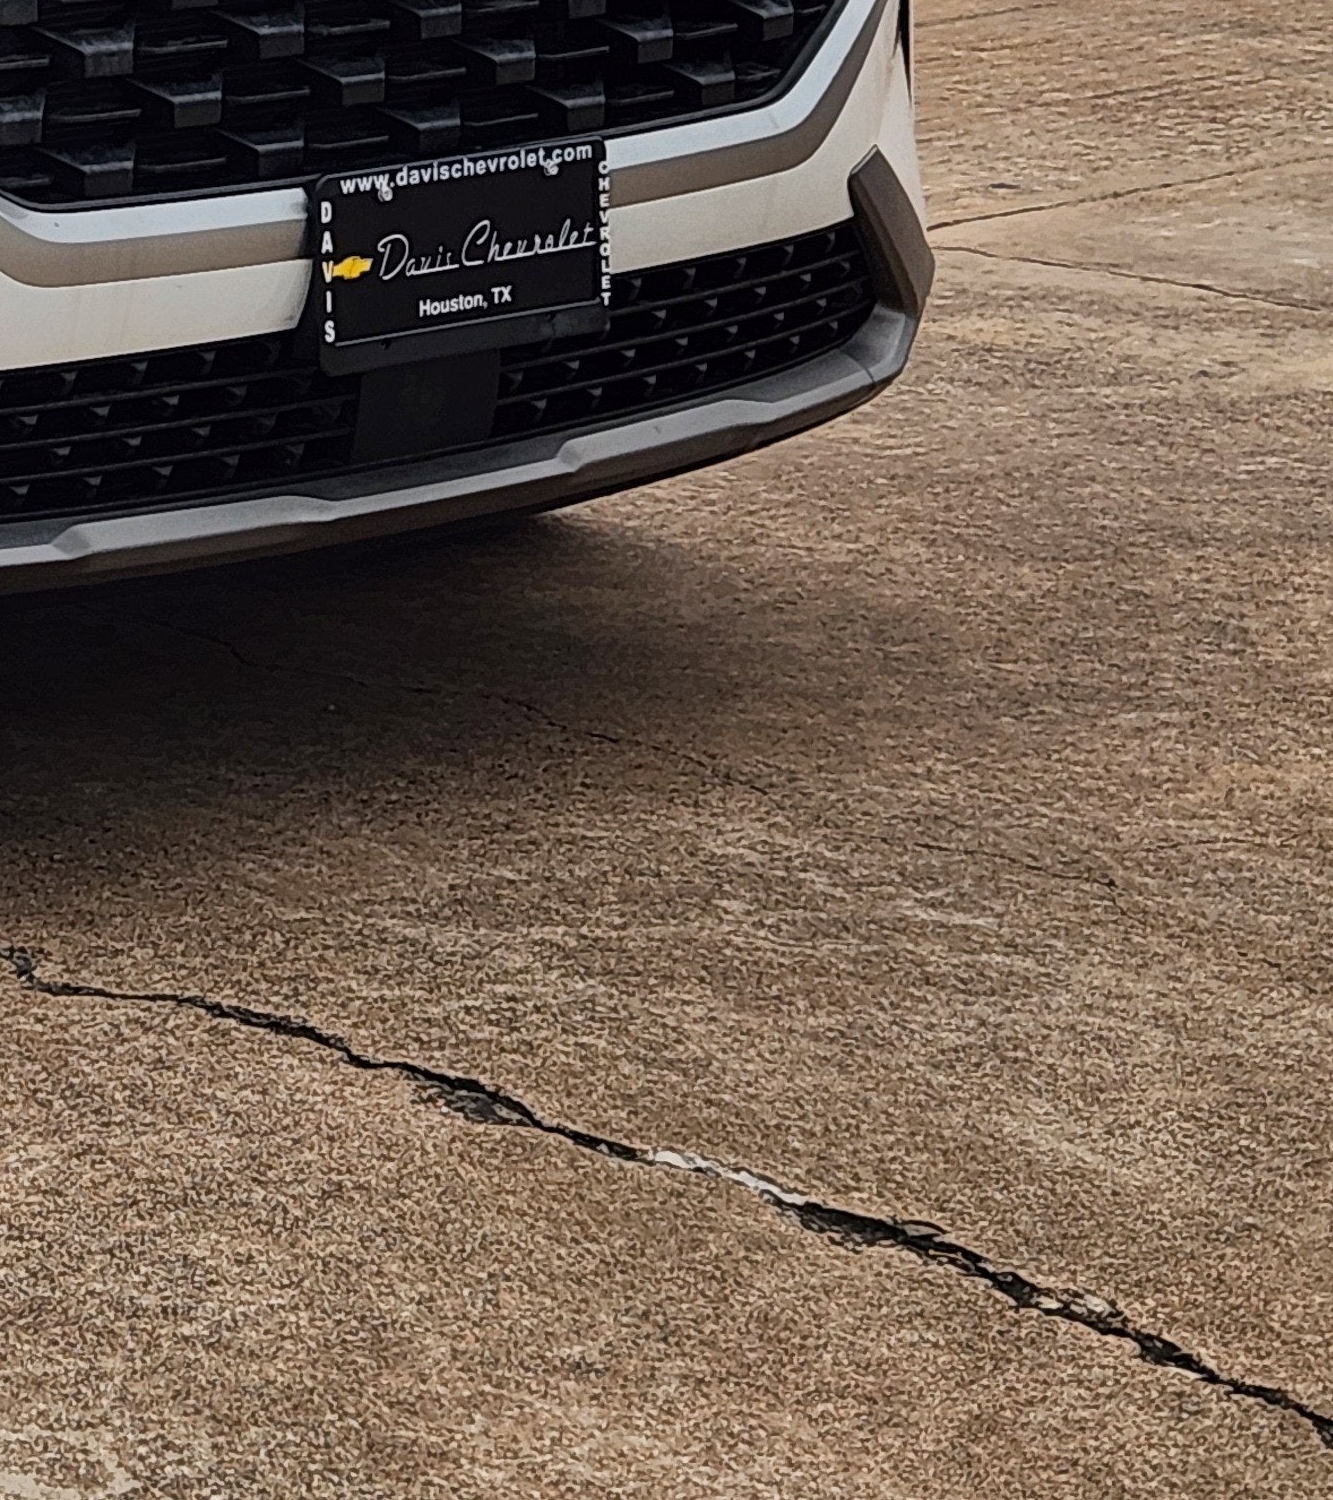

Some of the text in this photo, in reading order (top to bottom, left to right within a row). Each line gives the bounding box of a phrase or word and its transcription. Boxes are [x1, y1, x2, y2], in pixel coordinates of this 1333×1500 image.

[340, 144, 593, 195] www.davischevrolet.com
[320, 201, 336, 343] DAVIS
[378, 218, 597, 281] Davis Chevrolet
[419, 285, 512, 318] Houston, TX
